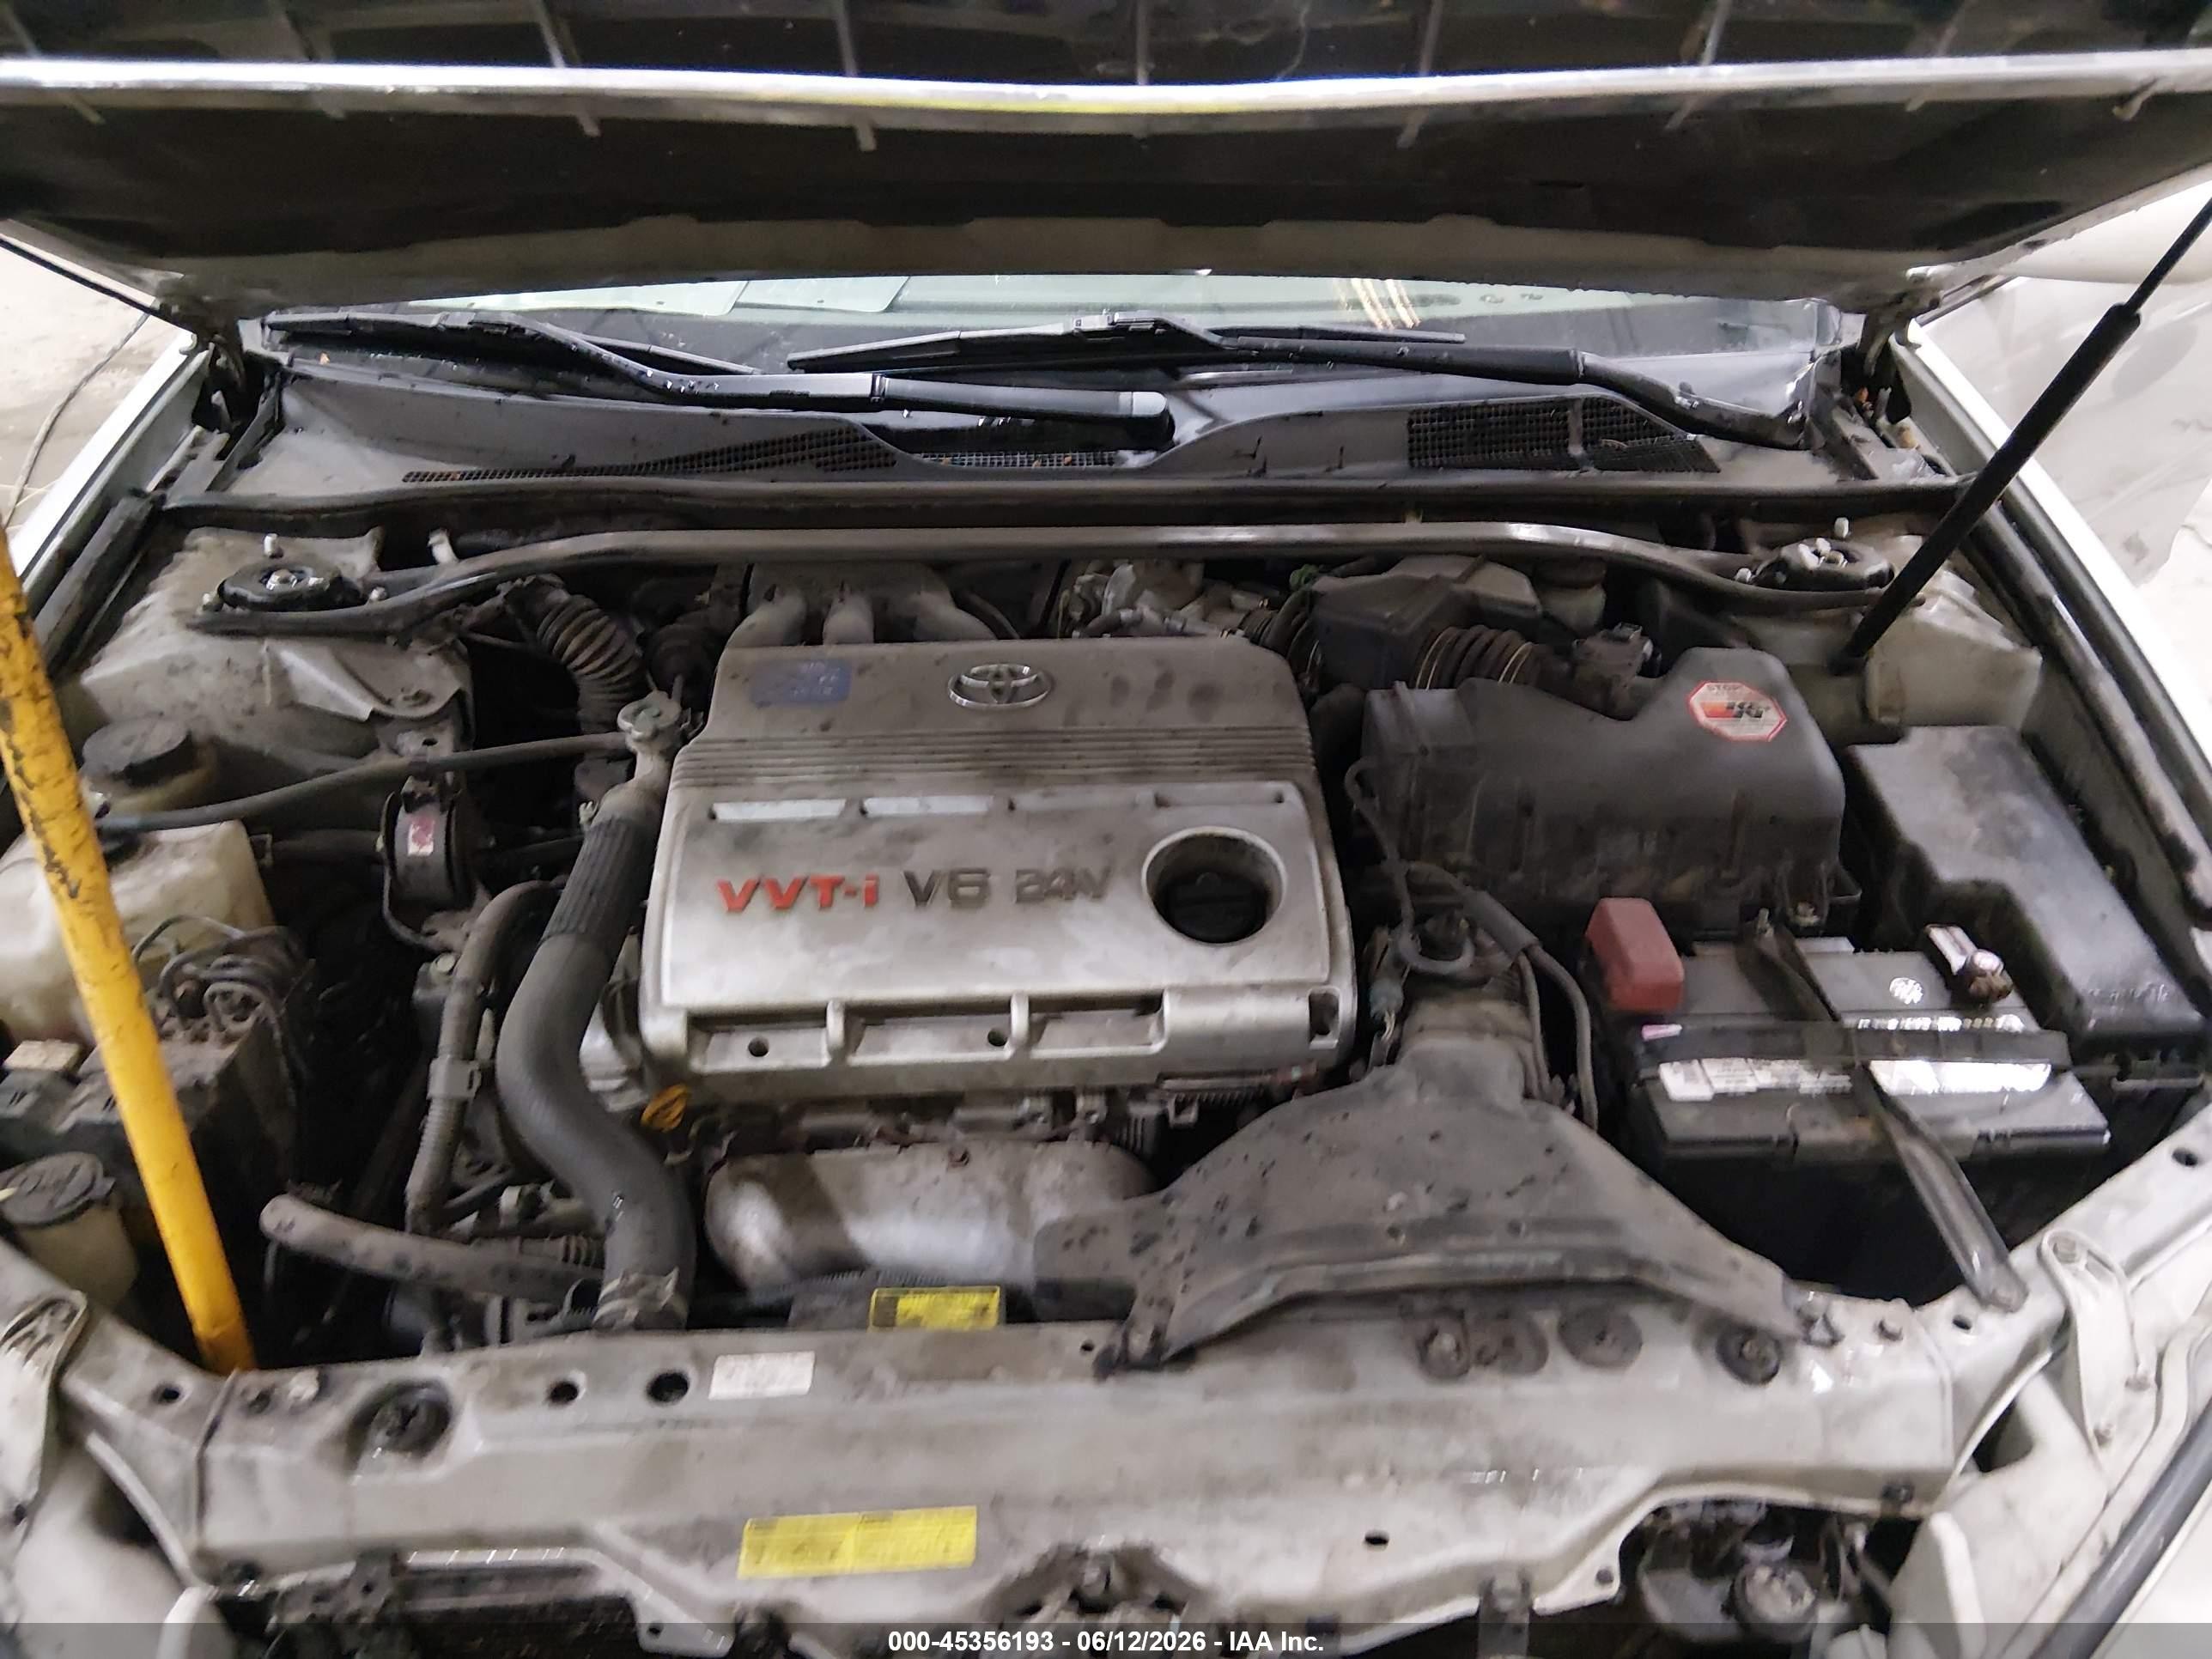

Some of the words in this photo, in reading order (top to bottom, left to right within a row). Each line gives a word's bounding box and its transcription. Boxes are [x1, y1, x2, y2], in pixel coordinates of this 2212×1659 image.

[716, 872, 880, 914] VVT-i
[902, 866, 991, 908] V6
[1014, 865, 1114, 904] 24V
